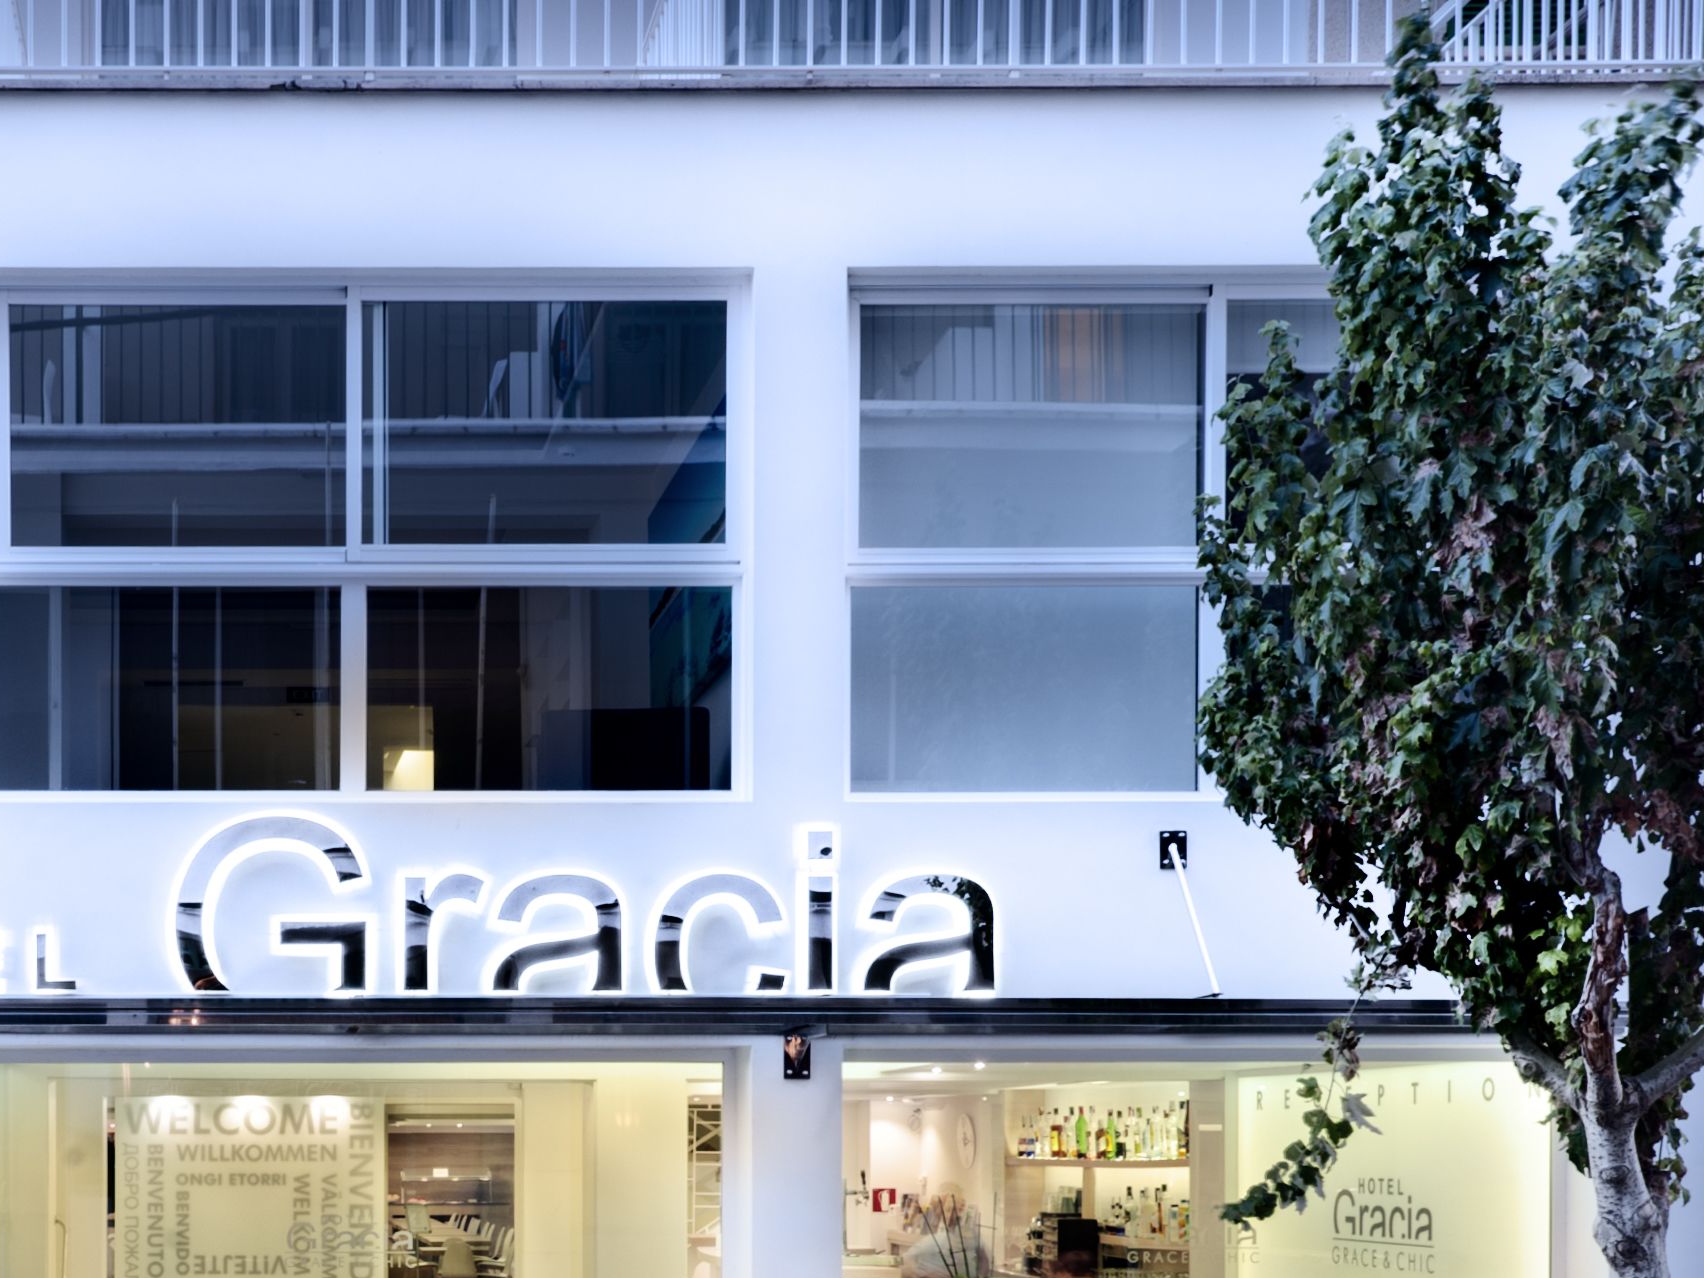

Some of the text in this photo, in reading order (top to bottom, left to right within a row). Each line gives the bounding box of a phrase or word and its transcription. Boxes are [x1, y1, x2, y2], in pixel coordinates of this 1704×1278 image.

[174, 815, 995, 992] Gracia
[124, 1102, 338, 1136] WELCOME
[176, 1143, 338, 1162] WILLKOMMEN
[175, 1172, 287, 1187] ONGI ETORRI
[1358, 1178, 1404, 1196] HOTEL
[145, 1143, 165, 1278] BENVENUTO
[1333, 1189, 1433, 1242] Gracia
[175, 1190, 191, 1277] BENVIDO
[1126, 1250, 1189, 1265] GRACE
[1331, 1246, 1435, 1274] GRACE & CHIC
